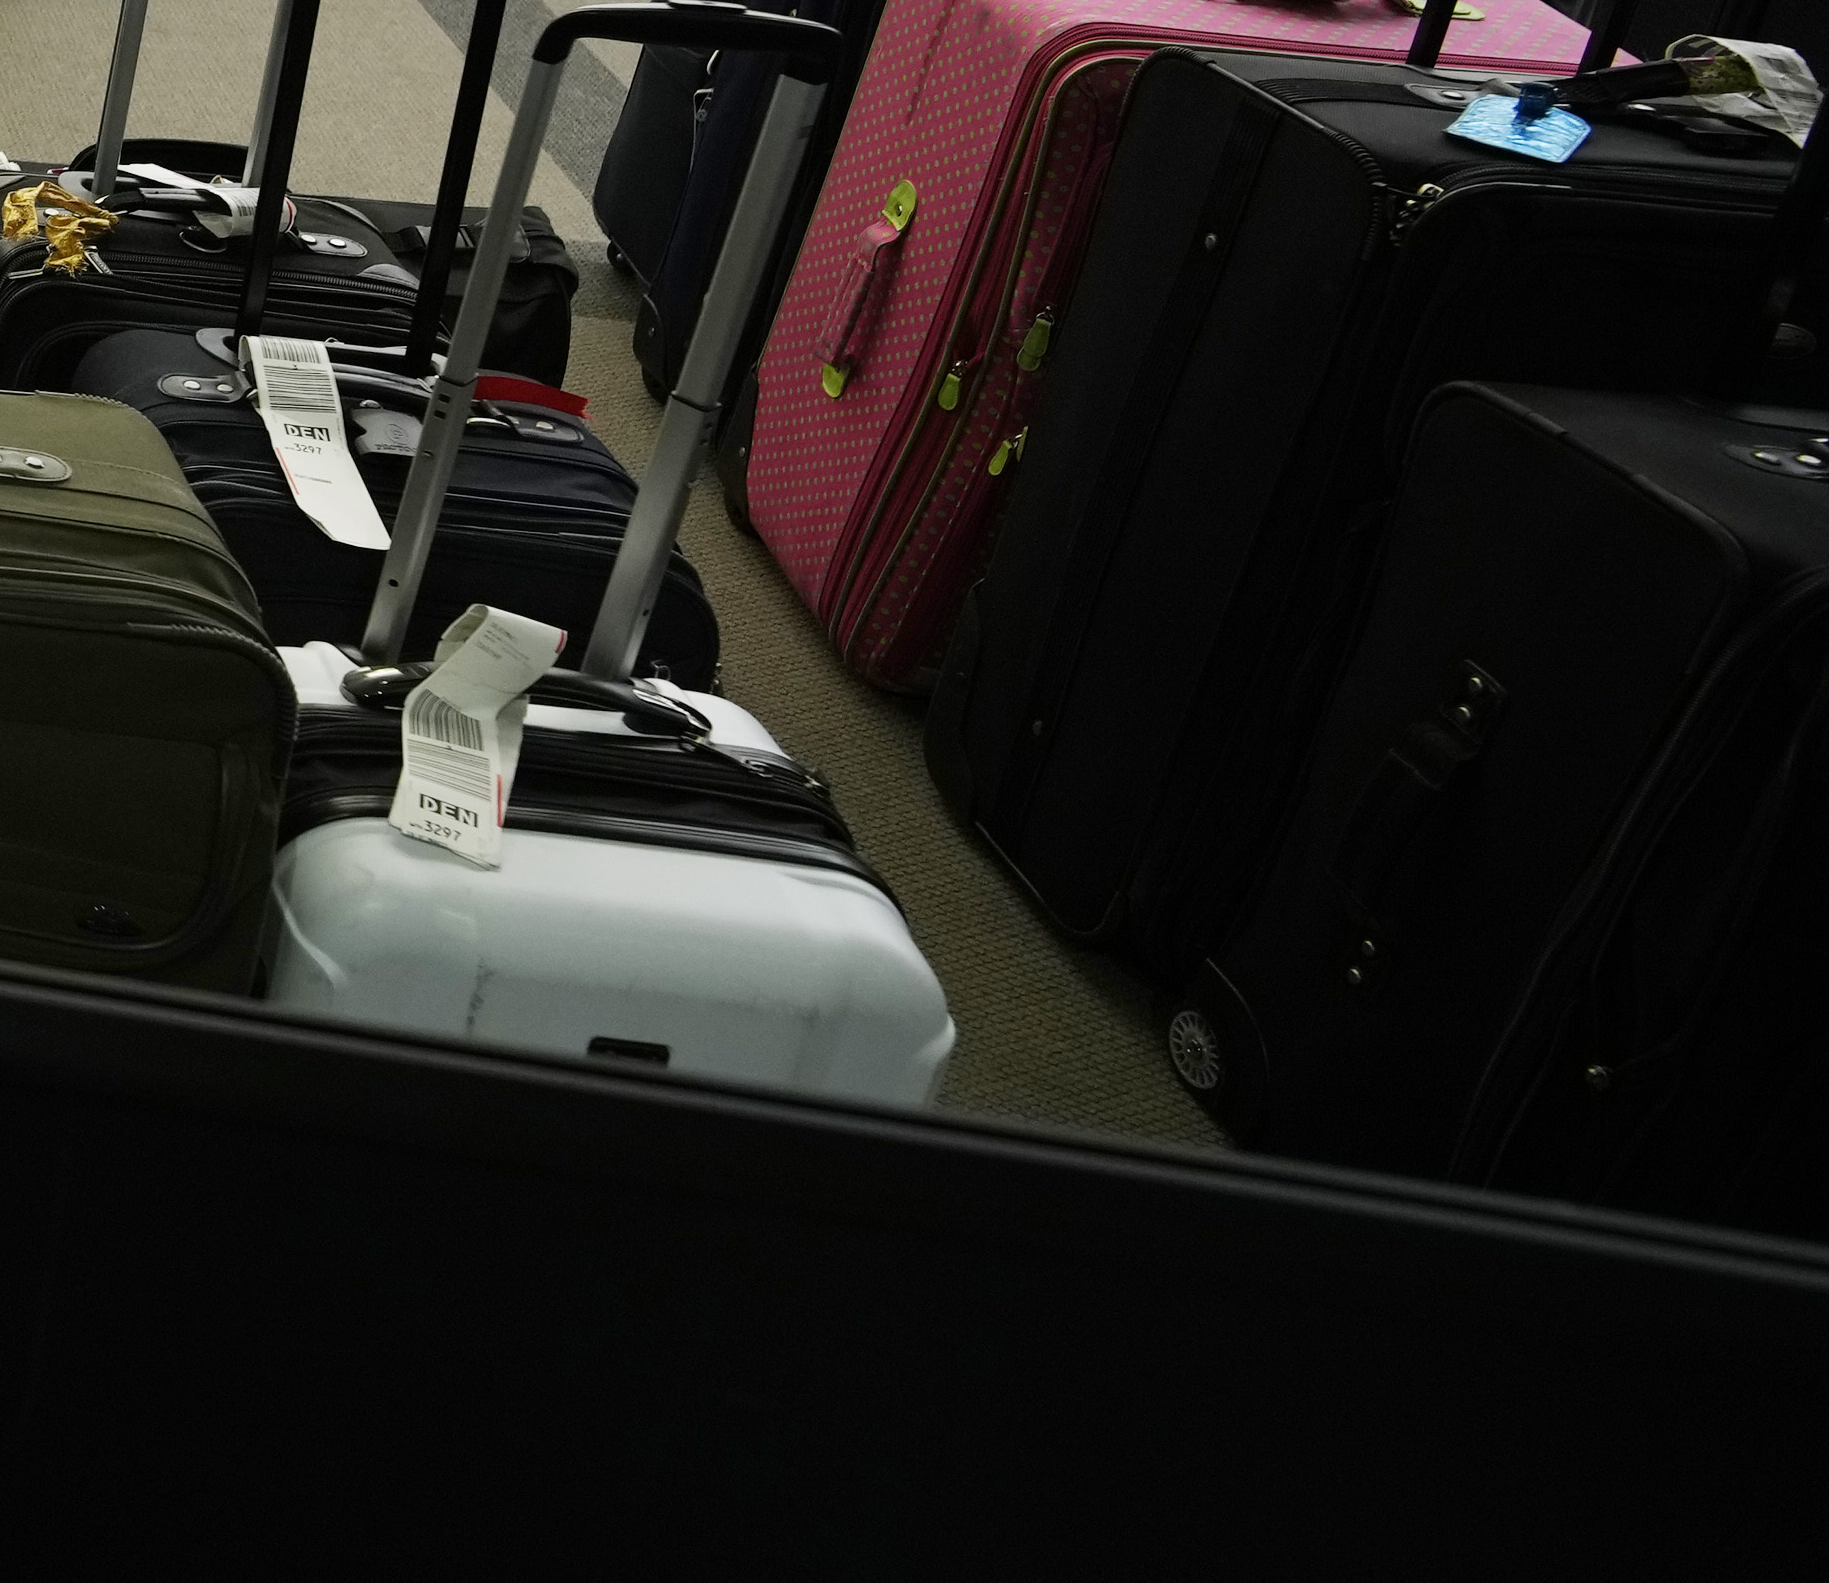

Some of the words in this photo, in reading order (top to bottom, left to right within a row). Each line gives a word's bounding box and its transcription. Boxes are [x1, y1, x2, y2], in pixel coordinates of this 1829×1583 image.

[284, 423, 332, 442] DEN
[292, 442, 323, 456] 3297
[420, 793, 478, 828] DEN
[423, 819, 462, 841] 3297
